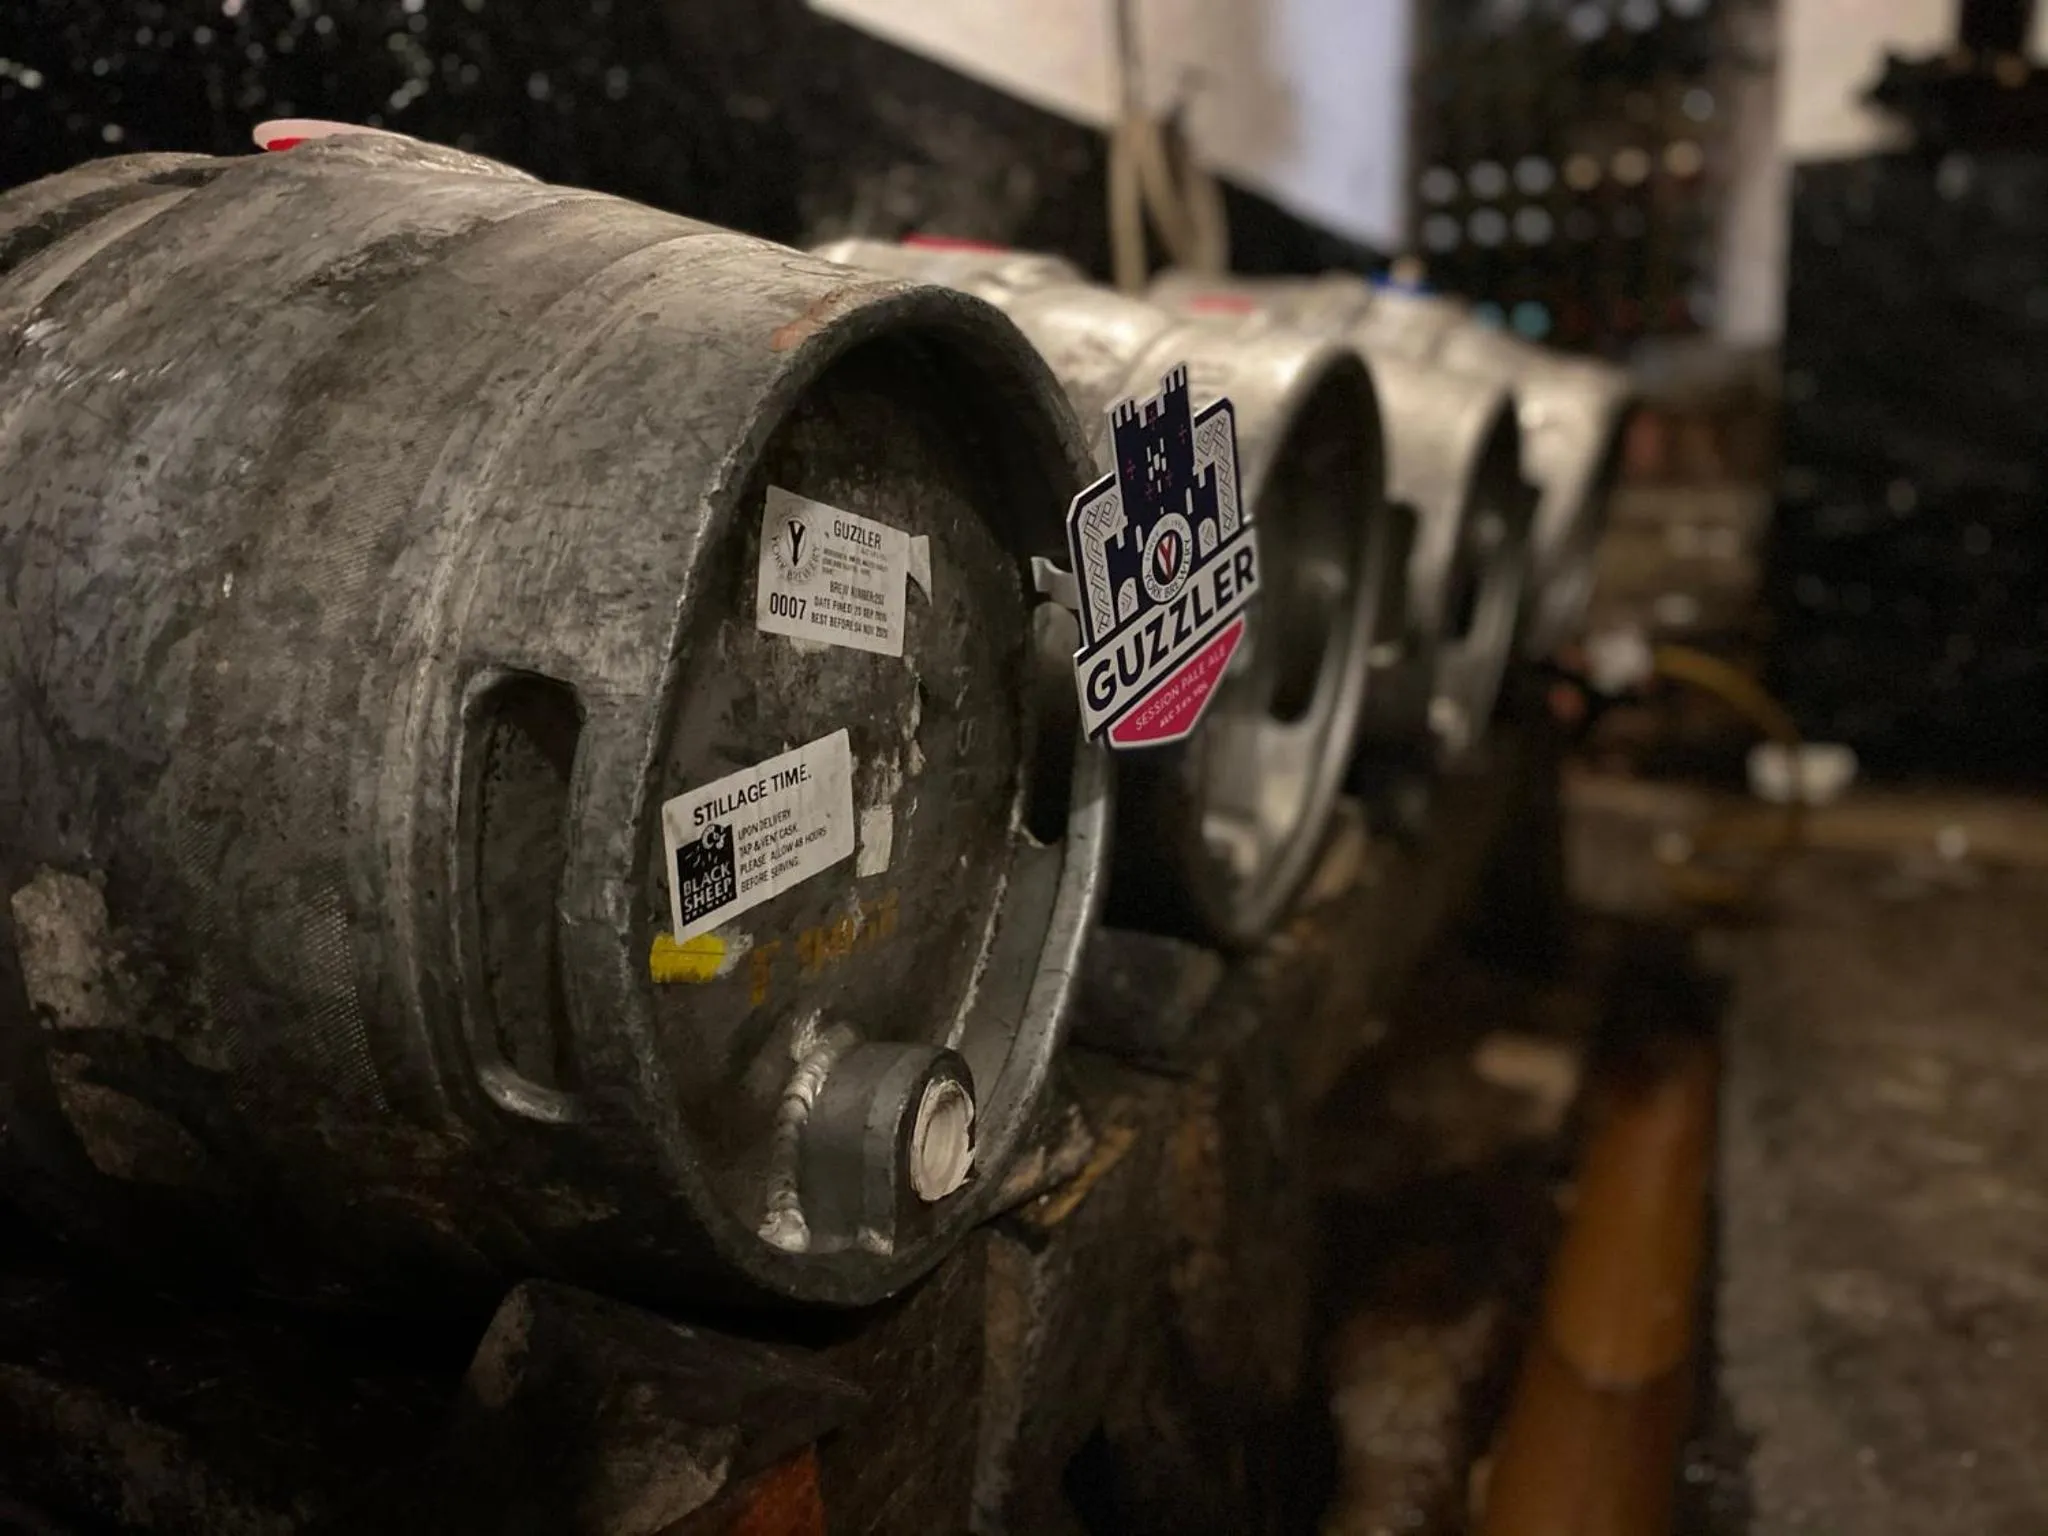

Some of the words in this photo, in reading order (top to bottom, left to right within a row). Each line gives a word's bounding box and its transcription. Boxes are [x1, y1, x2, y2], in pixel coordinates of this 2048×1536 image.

[834, 519, 882, 549] GUZZLER
[1145, 569, 1161, 599] YORK
[770, 592, 806, 620] 0007
[811, 611, 828, 626] BEST
[814, 595, 831, 610] DATE
[1086, 545, 1255, 712] GUZZLER
[1135, 684, 1181, 732] SESSION
[1181, 661, 1206, 691] PALE
[693, 779, 768, 827] STILLAGE
[770, 763, 812, 793] TIME.
[738, 822, 759, 841] UPON
[758, 808, 791, 832] DELIVERY
[739, 842, 753, 859] TAP
[779, 822, 798, 840] CASK
[740, 853, 767, 875] PLEASE
[770, 842, 793, 861] ALLOW
[804, 826, 828, 845] HOURS
[683, 861, 732, 897] BLACK
[684, 877, 732, 913] SHEEP
[741, 870, 769, 893] BEFORE
